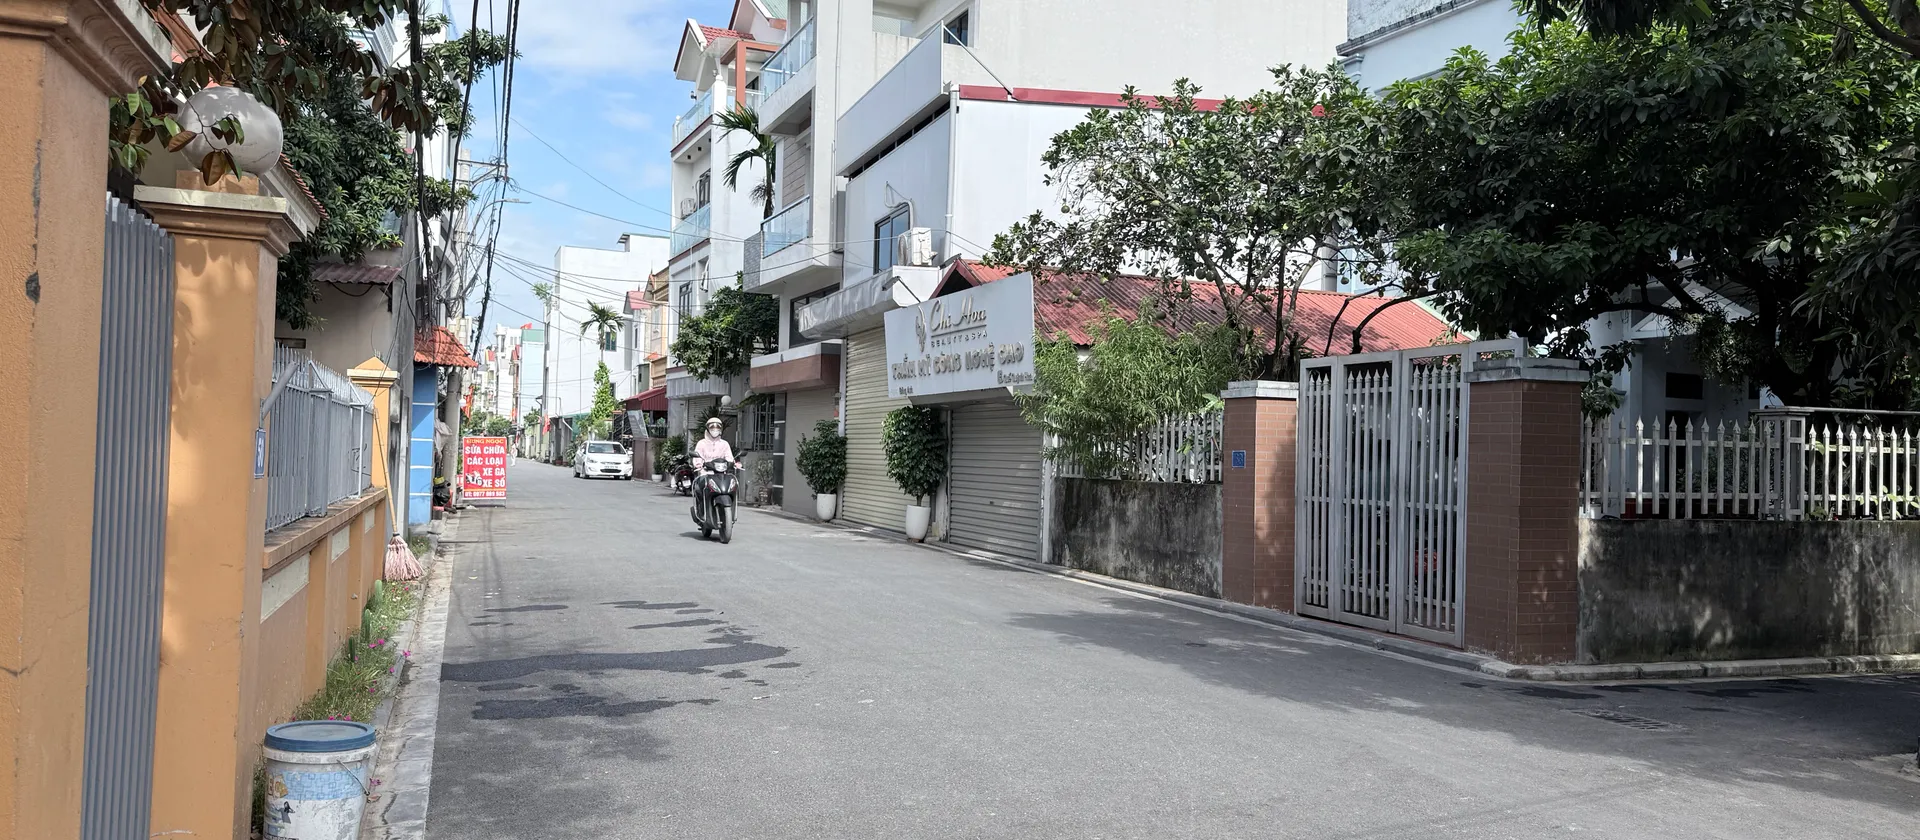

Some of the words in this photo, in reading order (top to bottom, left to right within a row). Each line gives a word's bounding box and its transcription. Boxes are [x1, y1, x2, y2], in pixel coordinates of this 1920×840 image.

[930, 299, 951, 332] Chi
[998, 341, 1024, 364] CAO
[465, 444, 481, 454] SỬA
[483, 445, 505, 454] CHỮA
[467, 456, 483, 465] CÁC
[485, 457, 503, 467] LOẠI
[483, 468, 493, 476] XE
[495, 468, 505, 476] GA
[483, 479, 493, 487] XE
[495, 476, 505, 487] SỐ
